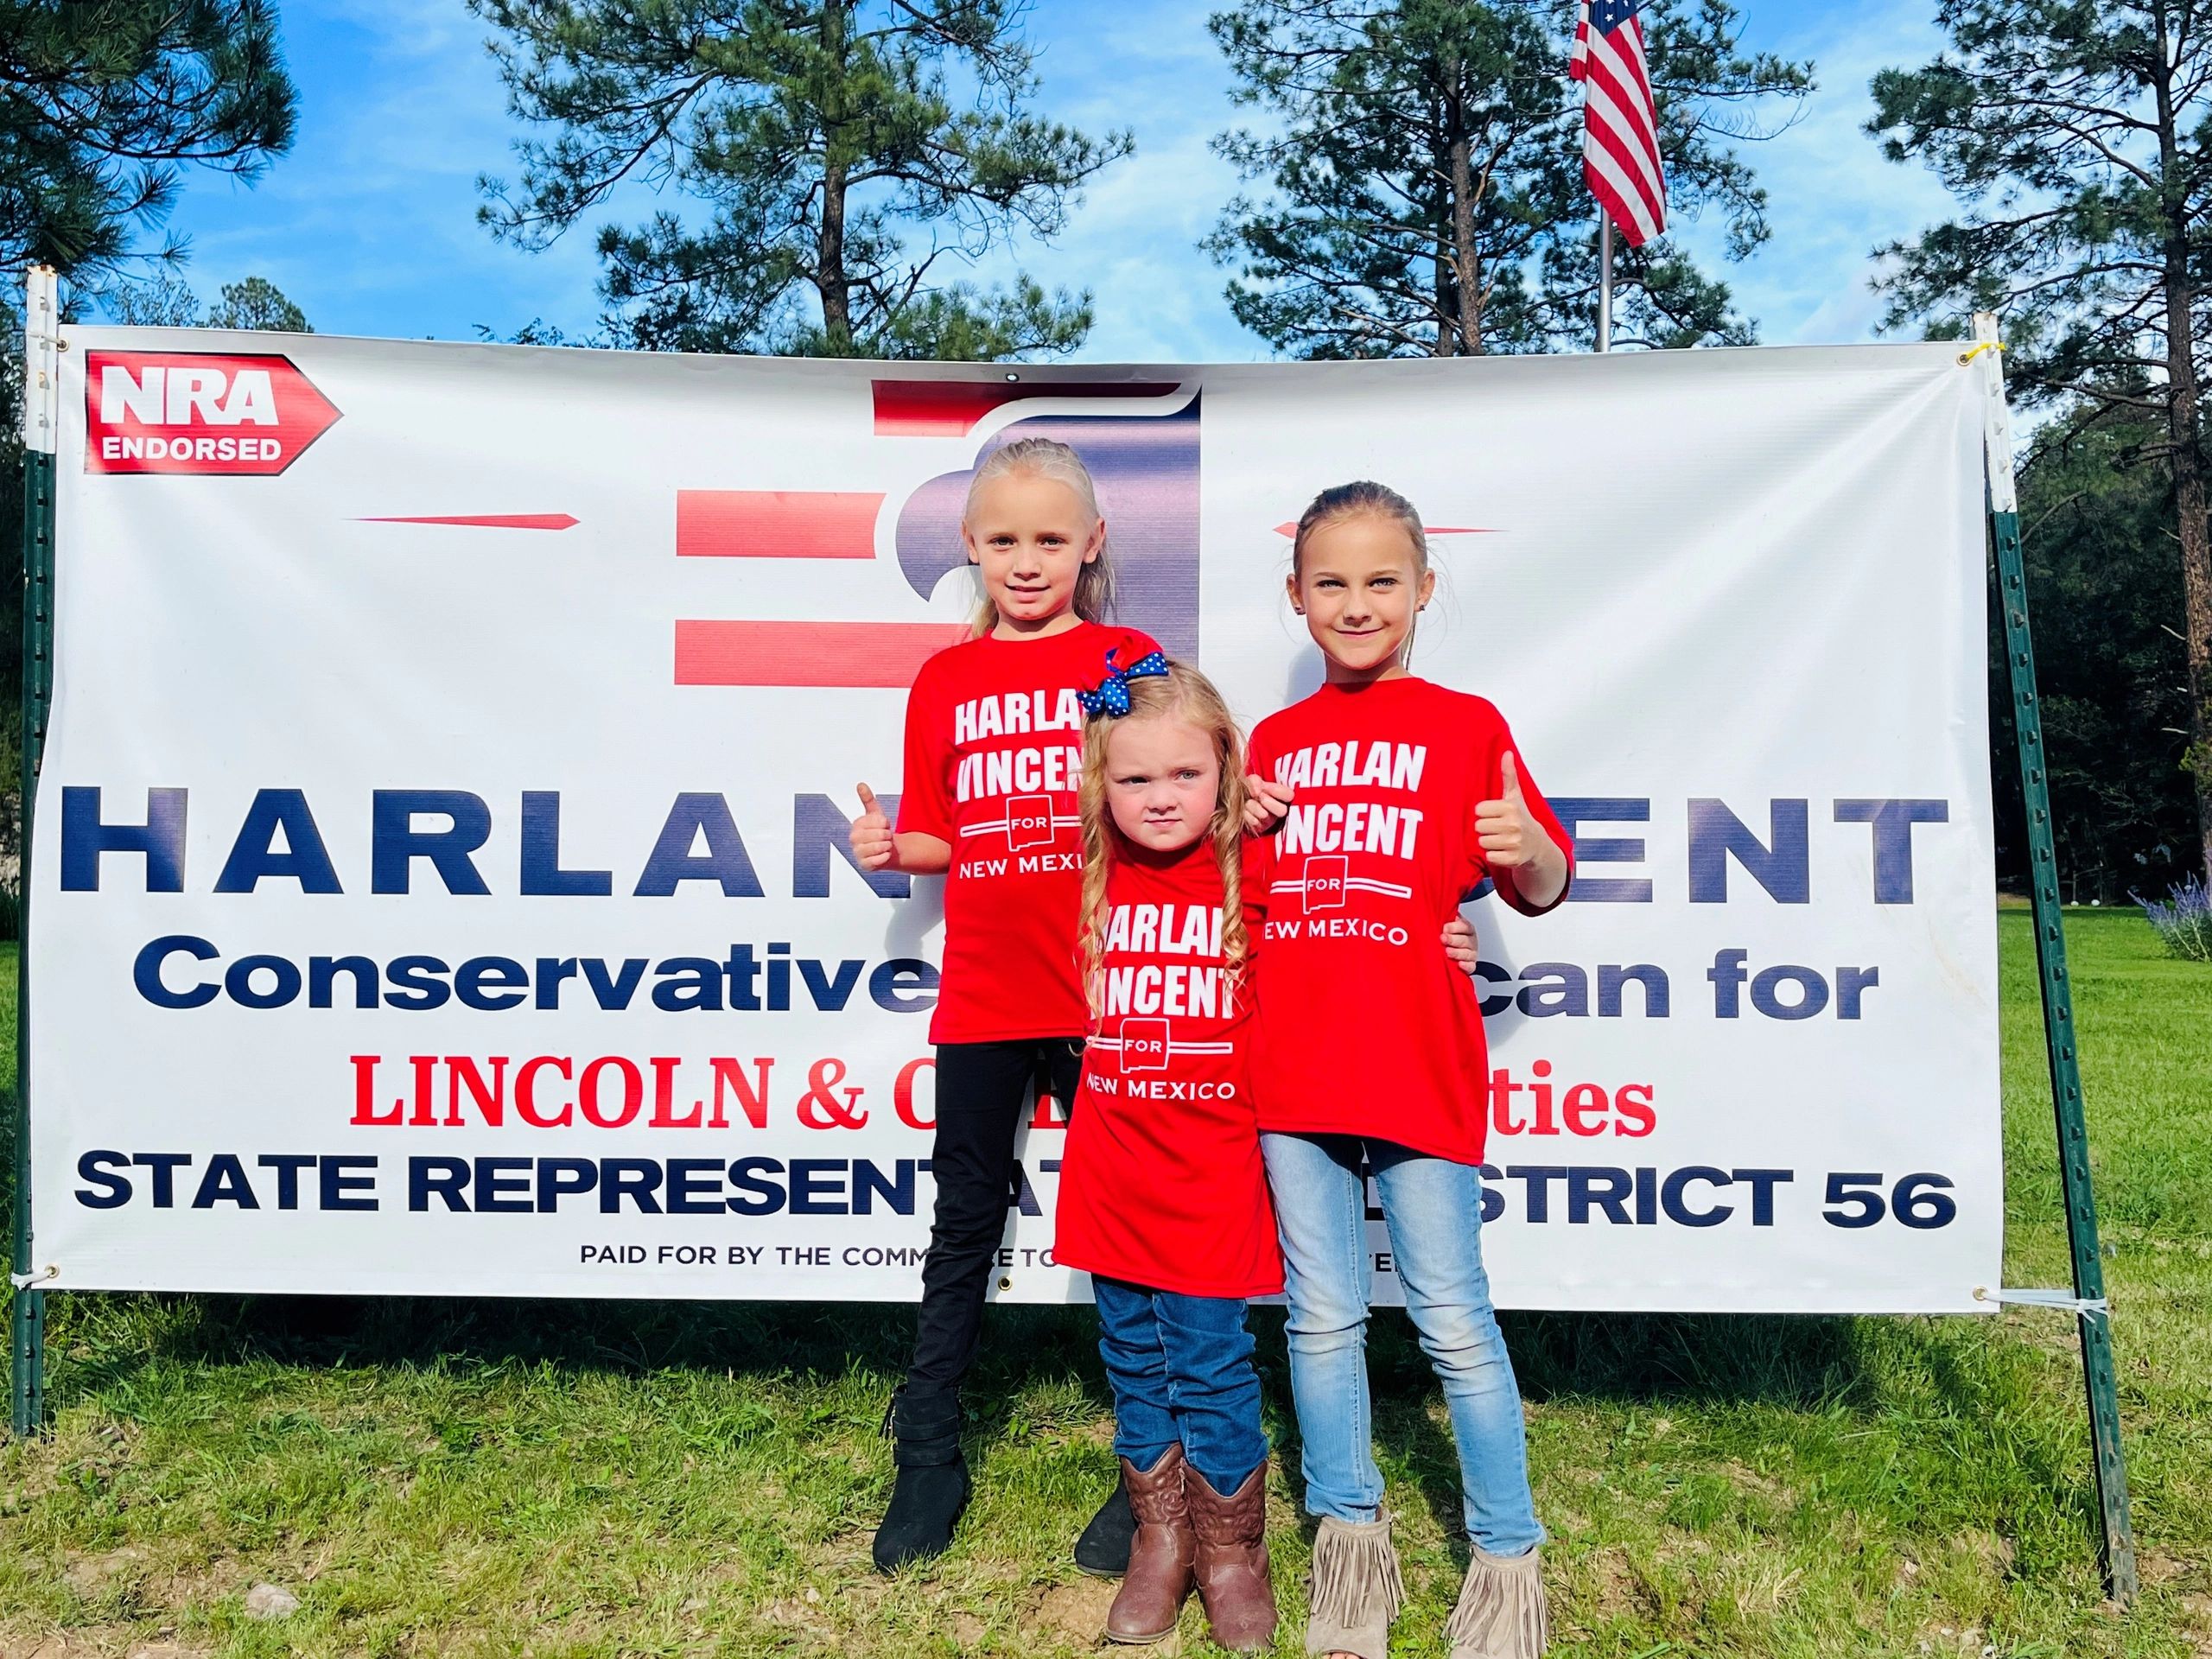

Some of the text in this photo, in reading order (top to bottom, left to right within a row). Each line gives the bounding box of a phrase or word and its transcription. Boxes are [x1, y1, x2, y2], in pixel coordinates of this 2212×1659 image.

[100, 365, 279, 426] NRA
[102, 437, 282, 461] ENDORSED
[955, 689, 1083, 745] HARLA
[957, 746, 1084, 803] VINCEN
[1274, 741, 1427, 792] HARLAN
[60, 785, 911, 898] HARLAN
[1011, 817, 1047, 830] FOR
[1275, 803, 1424, 862] NCENT
[959, 853, 1083, 880] NEW MEXI
[1306, 878, 1341, 892] FOR
[1264, 918, 1408, 946] EW MEXICO
[133, 935, 938, 1012] Conservative
[1707, 948, 1878, 1020] for
[1124, 1039, 1162, 1052] FOR
[350, 1055, 774, 1129] LINCOLN
[797, 1058, 868, 1130] &
[1489, 1059, 1656, 1137] ties
[1086, 1072, 1236, 1101] NEW MEXICO
[74, 1150, 378, 1211] STATE
[1822, 1173, 1956, 1230] 56
[581, 1245, 646, 1265] PAID
[658, 1246, 716, 1265] FOR
[728, 1246, 765, 1266] BY
[776, 1247, 830, 1266] THE
